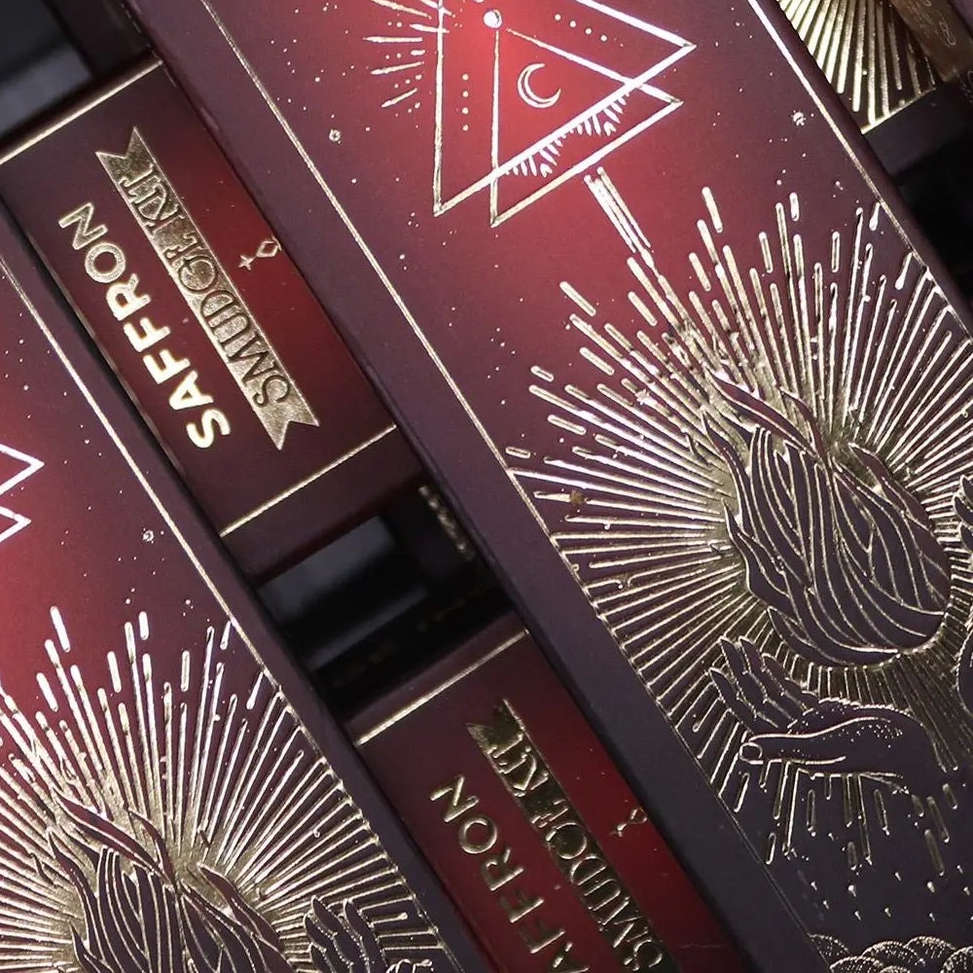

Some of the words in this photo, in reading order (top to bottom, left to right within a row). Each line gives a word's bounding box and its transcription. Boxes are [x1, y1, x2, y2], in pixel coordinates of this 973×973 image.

[116, 163, 185, 238] KIT
[58, 202, 230, 448] SAFFRON
[162, 232, 291, 408] SMUDGE
